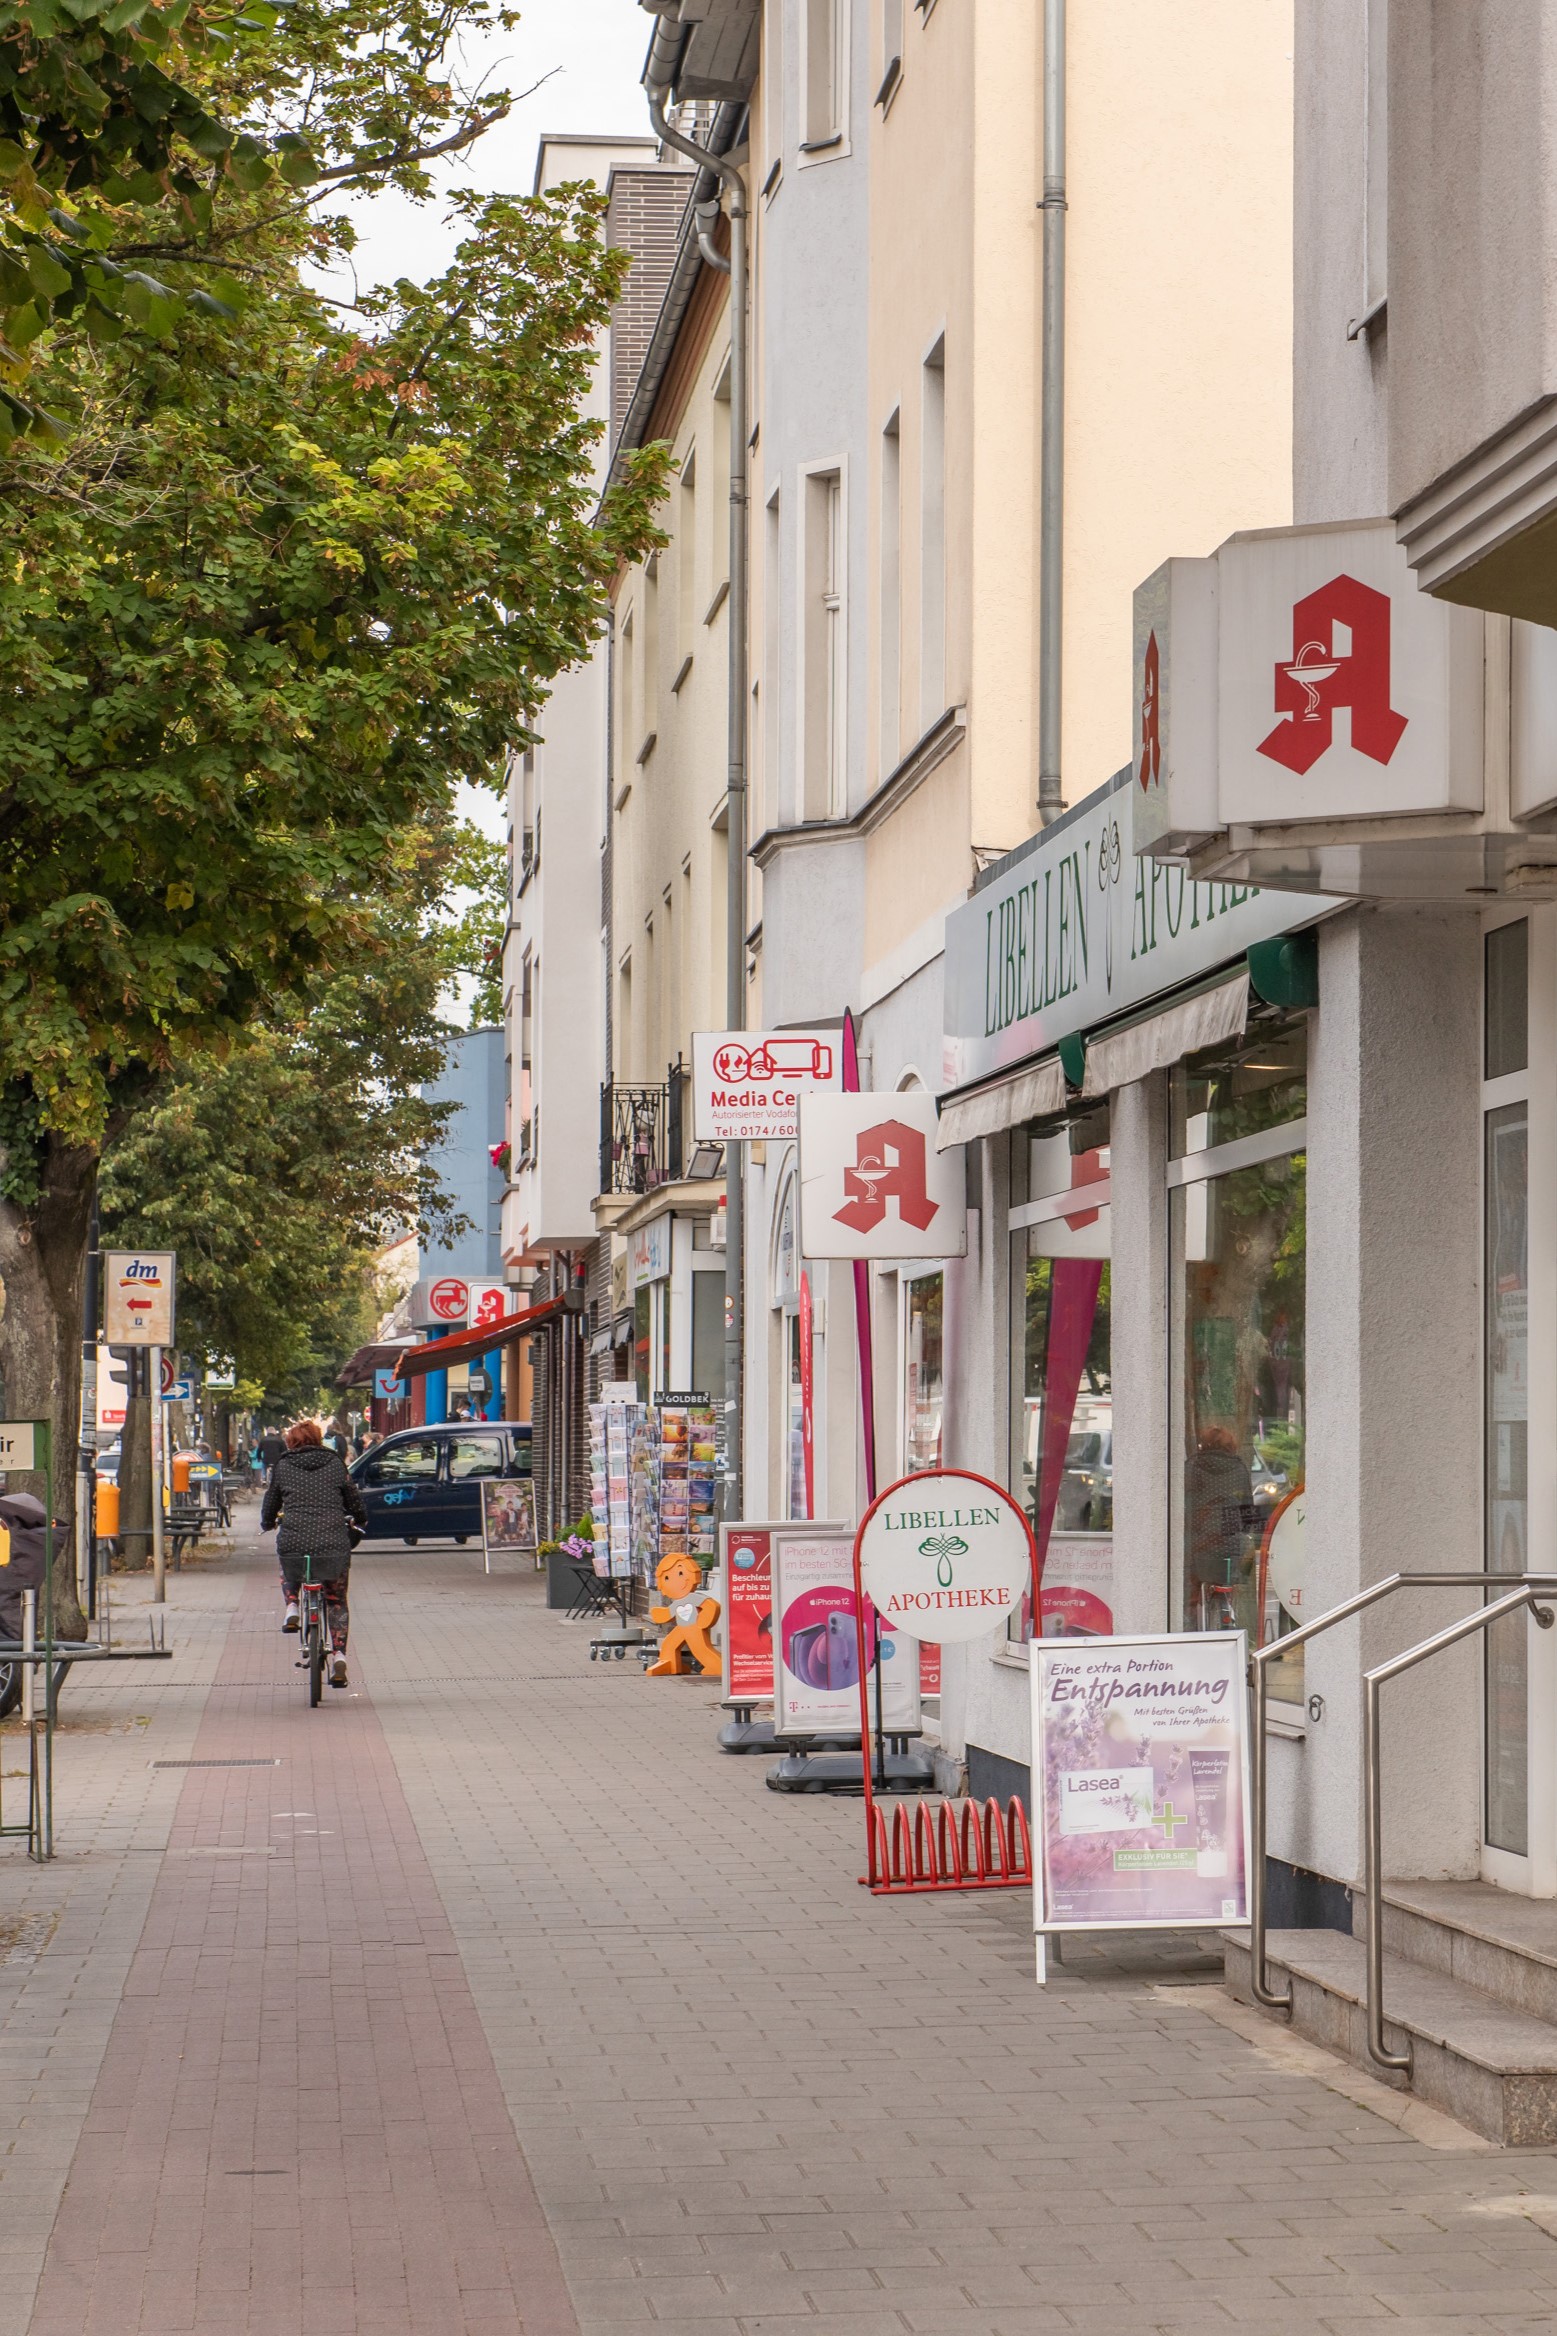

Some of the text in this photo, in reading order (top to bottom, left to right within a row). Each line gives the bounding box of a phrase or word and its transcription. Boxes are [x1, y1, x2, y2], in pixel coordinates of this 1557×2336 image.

[984, 840, 1091, 1038] LIBELLEN
[711, 1090, 797, 1107] Media Ce
[711, 1110, 764, 1119] Autorisierter
[714, 1126, 738, 1136] Tel:
[126, 1260, 157, 1278] dm
[665, 1395, 709, 1403] GOLDBEK
[884, 1507, 1000, 1531] LIBELLEN
[784, 1546, 816, 1556] iPhone
[820, 1546, 829, 1556] 12
[831, 1546, 851, 1556] mit
[784, 1560, 797, 1569] im
[799, 1559, 831, 1569] besten
[732, 1583, 746, 1591] auf
[746, 1583, 758, 1591] bis
[732, 1592, 744, 1601] für
[886, 1587, 1011, 1612] APOTHEKE
[1050, 1658, 1174, 1676] Eine extra Portion
[1051, 1677, 1230, 1708] Entspannung
[1133, 1705, 1208, 1717] Mit besten Grüßen
[1169, 1717, 1191, 1726] Ihrer
[1193, 1715, 1231, 1726] Apotheke
[1118, 1853, 1155, 1861] EXKLUSIV
[1155, 1852, 1172, 1860] FÜR
